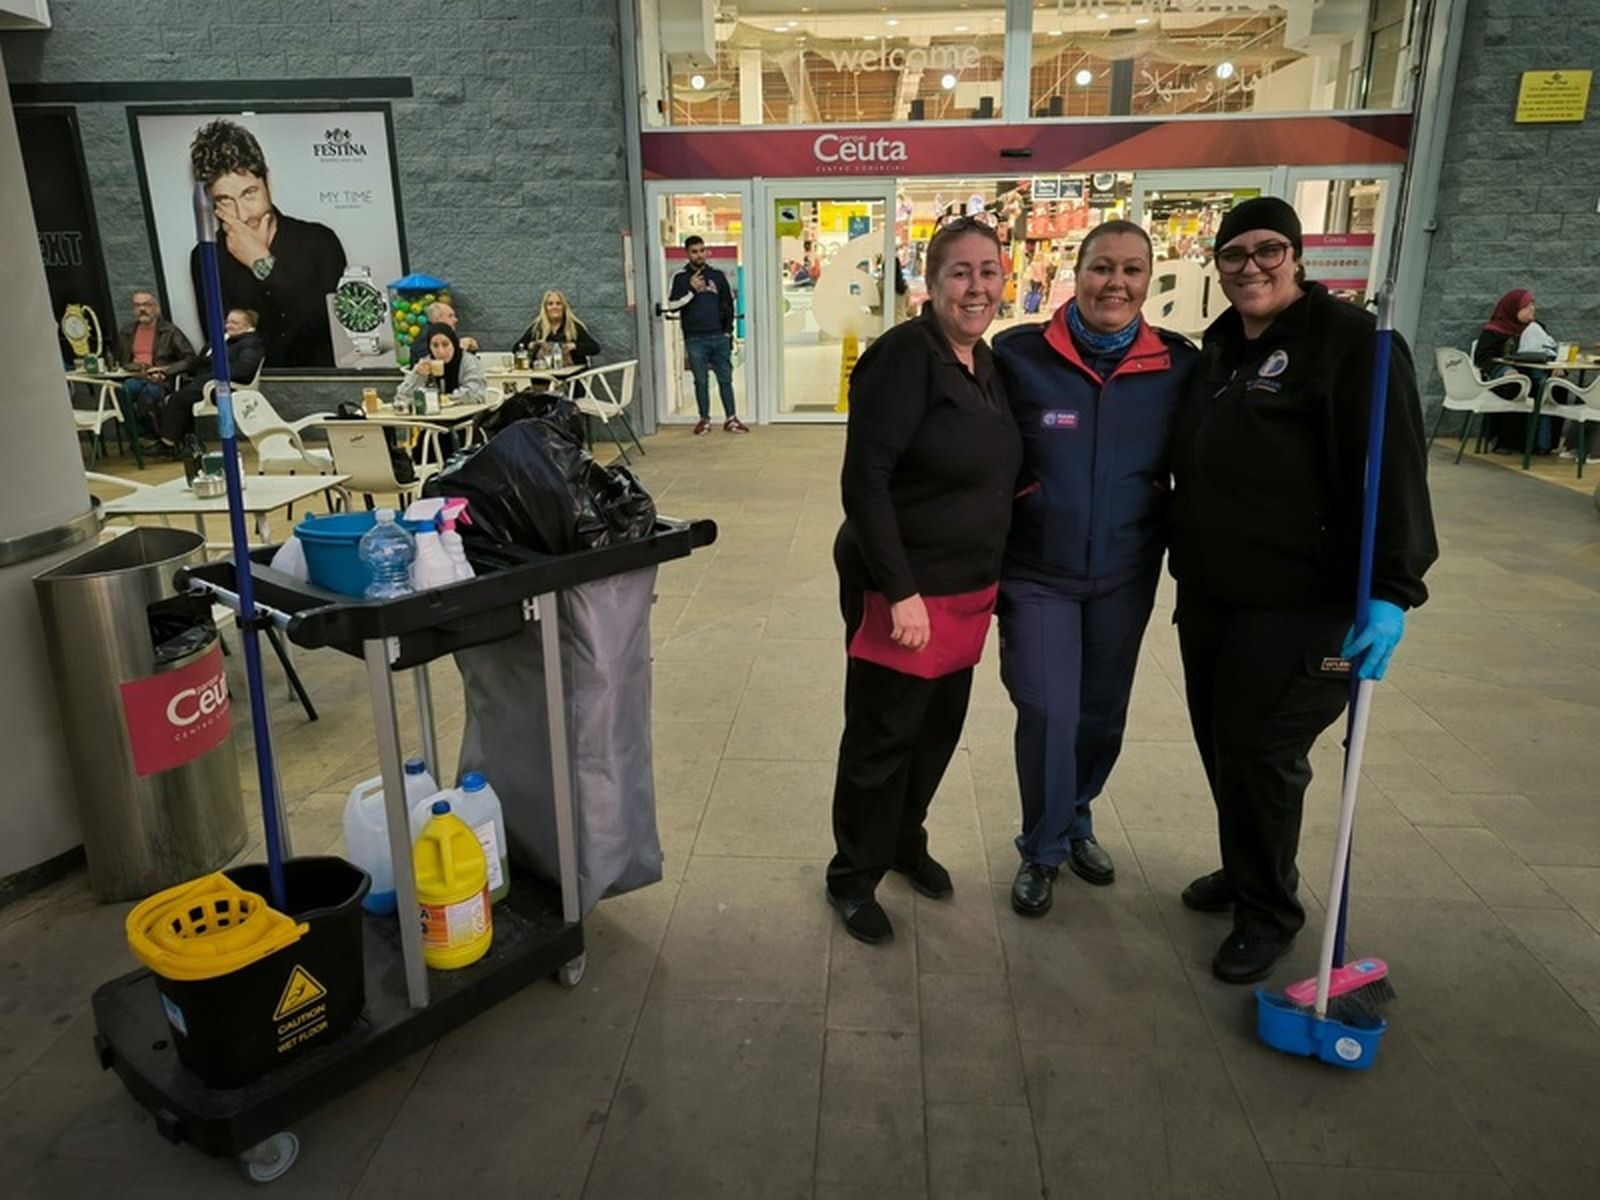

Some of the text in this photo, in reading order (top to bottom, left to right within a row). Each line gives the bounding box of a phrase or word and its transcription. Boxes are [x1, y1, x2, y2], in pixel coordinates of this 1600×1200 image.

[830, 36, 980, 73] welcome
[313, 143, 367, 156] FESTINA
[814, 133, 908, 162] Ceuta
[319, 190, 373, 204] MY TIME
[278, 1003, 326, 1035] CAUTION
[278, 1020, 328, 1053] WET FLOOR
